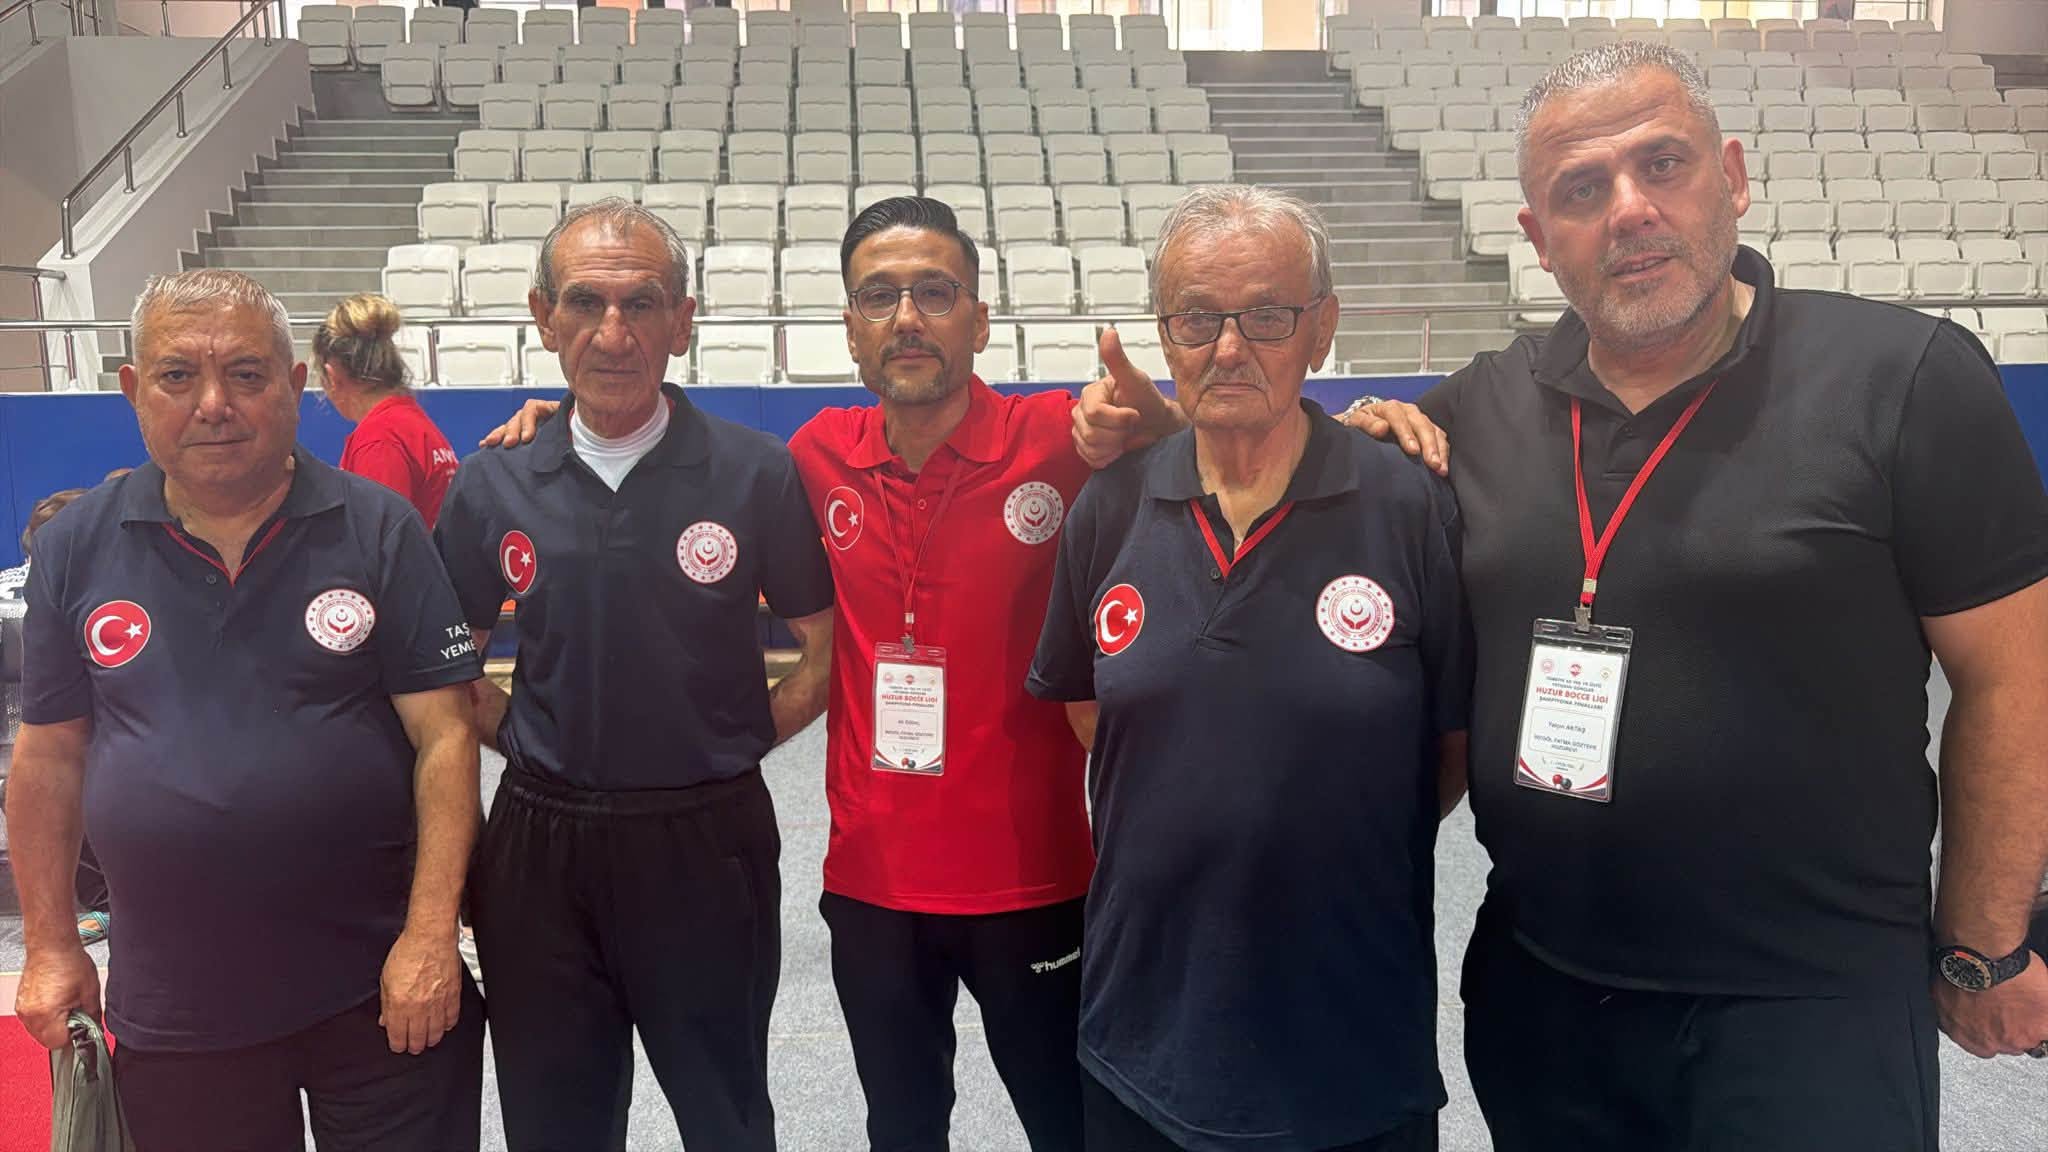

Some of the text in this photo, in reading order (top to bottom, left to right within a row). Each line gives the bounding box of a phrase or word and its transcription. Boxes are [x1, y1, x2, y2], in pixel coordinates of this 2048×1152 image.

[1536, 686, 1563, 697] HUZUR
[1565, 690, 1590, 701] BOCCE
[1044, 946, 1080, 971] hummel
